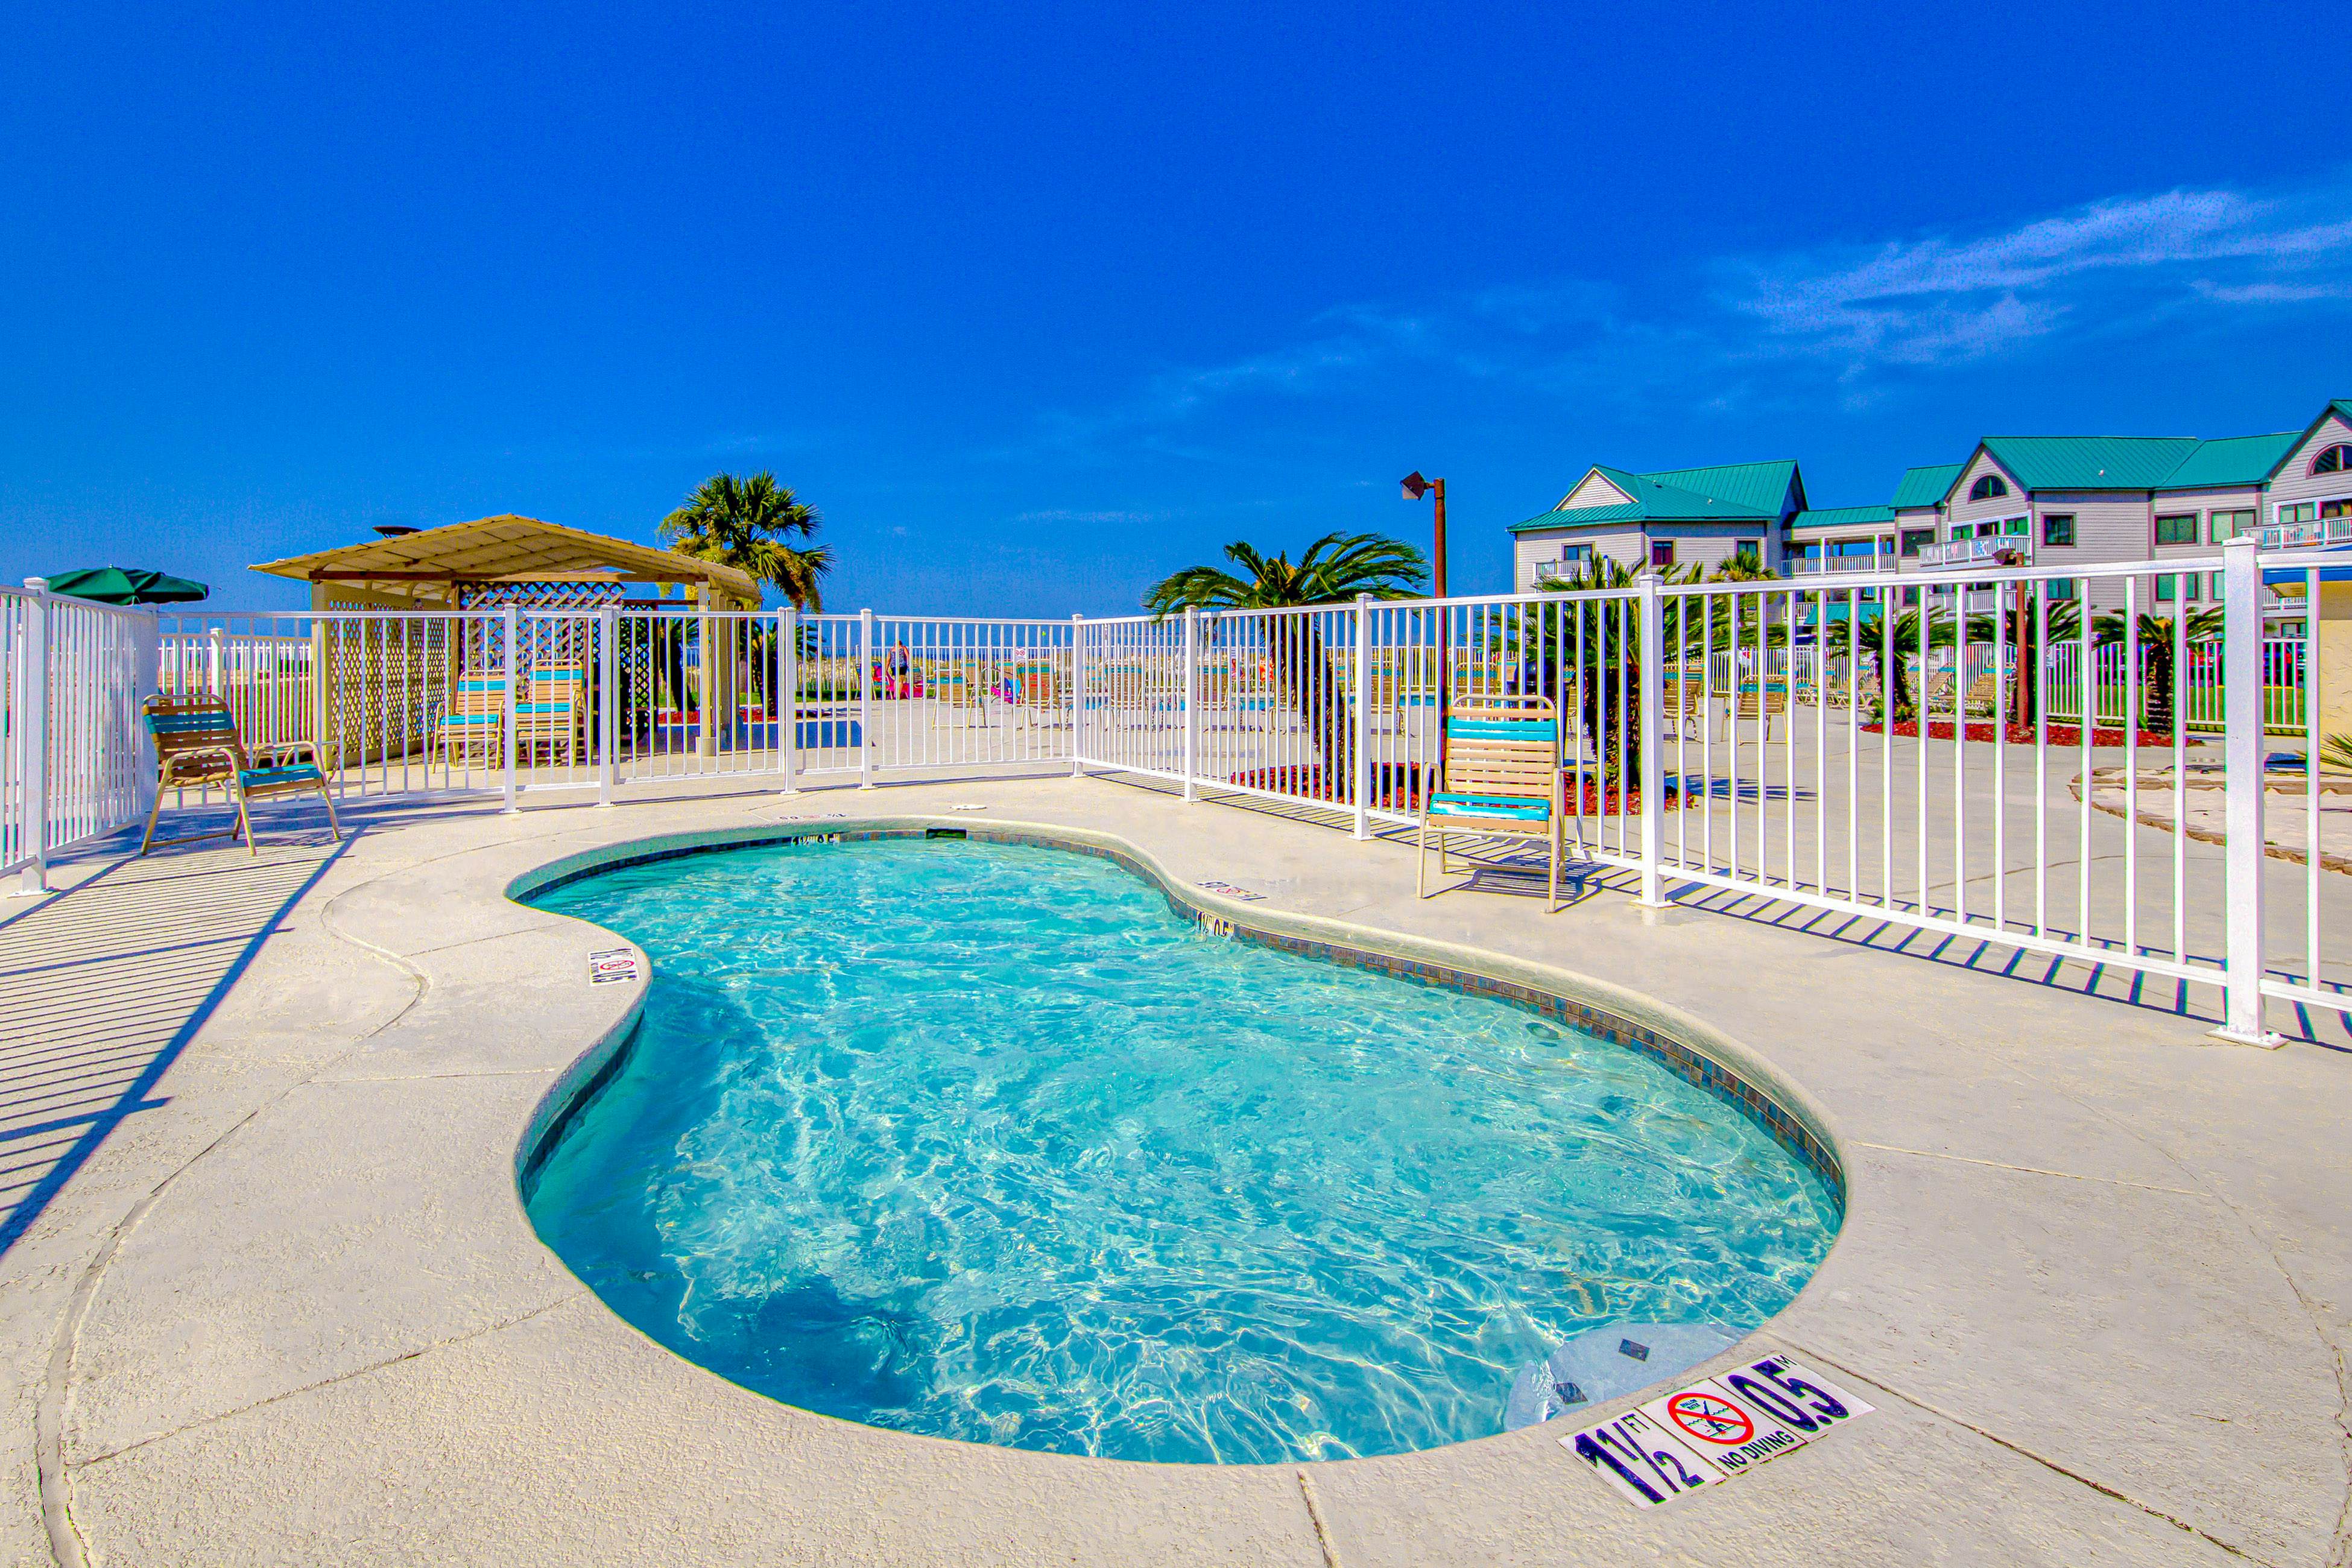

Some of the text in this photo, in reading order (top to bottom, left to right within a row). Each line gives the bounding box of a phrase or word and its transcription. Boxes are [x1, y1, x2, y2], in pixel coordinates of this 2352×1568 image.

[1728, 1355, 1849, 1432] 0.5 M
[1620, 1413, 1649, 1433] FT
[1716, 1430, 1795, 1470] NO DIVING
